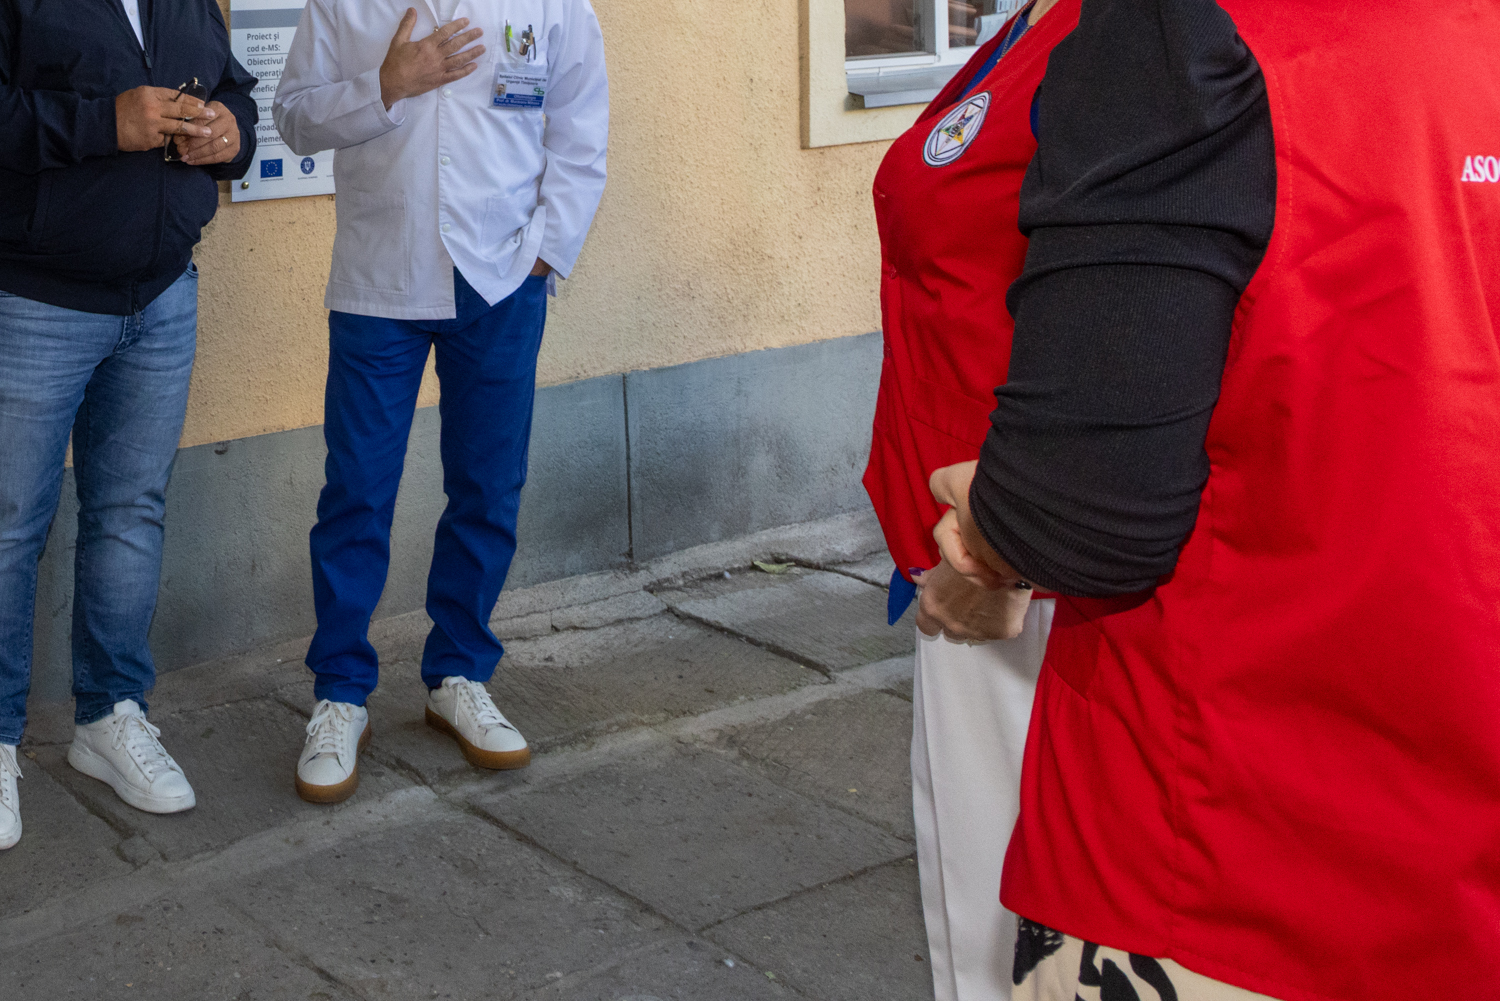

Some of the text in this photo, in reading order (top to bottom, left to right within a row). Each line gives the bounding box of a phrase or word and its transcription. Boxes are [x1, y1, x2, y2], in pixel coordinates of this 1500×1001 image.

[246, 32, 280, 41] Proiect și
[246, 43, 281, 53] cod e-MS:
[247, 57, 284, 66] Obiectivul
[1461, 154, 1500, 183] ASO
